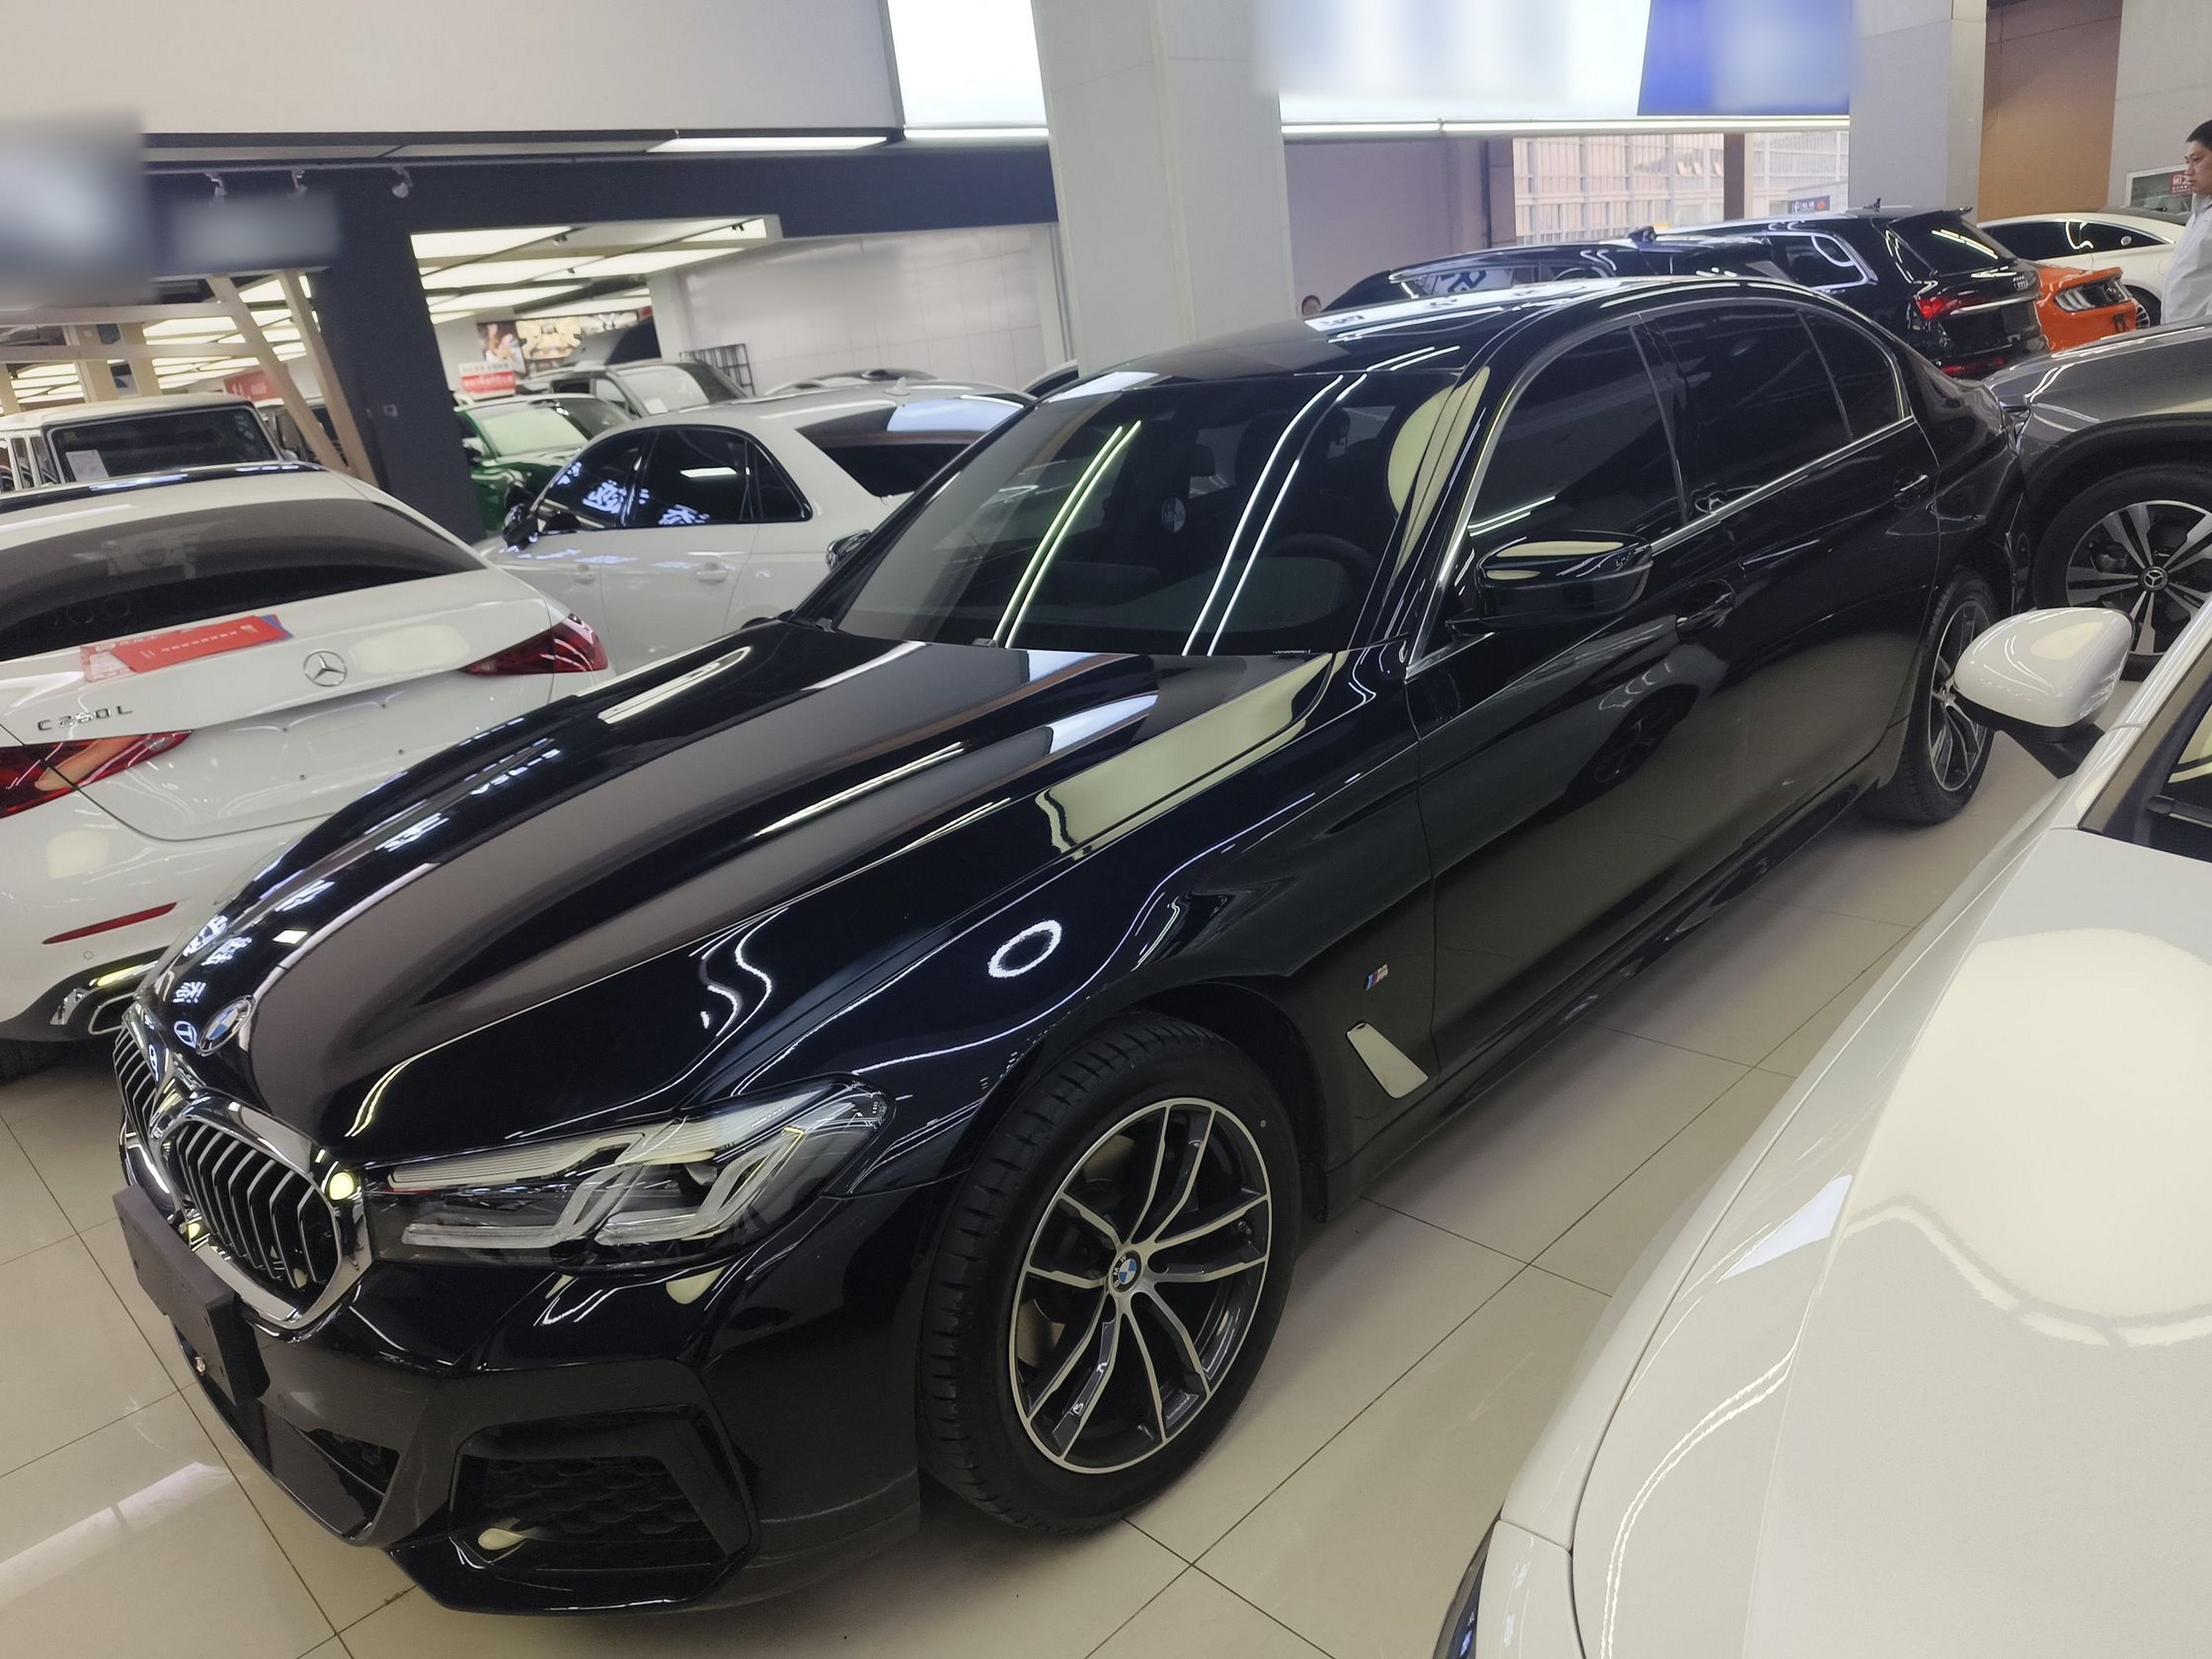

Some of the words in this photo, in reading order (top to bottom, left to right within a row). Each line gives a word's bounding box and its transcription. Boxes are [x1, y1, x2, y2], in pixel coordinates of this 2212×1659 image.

[37, 719, 52, 731] C
[116, 705, 134, 715] L
[1113, 1254, 1127, 1289] BMW
